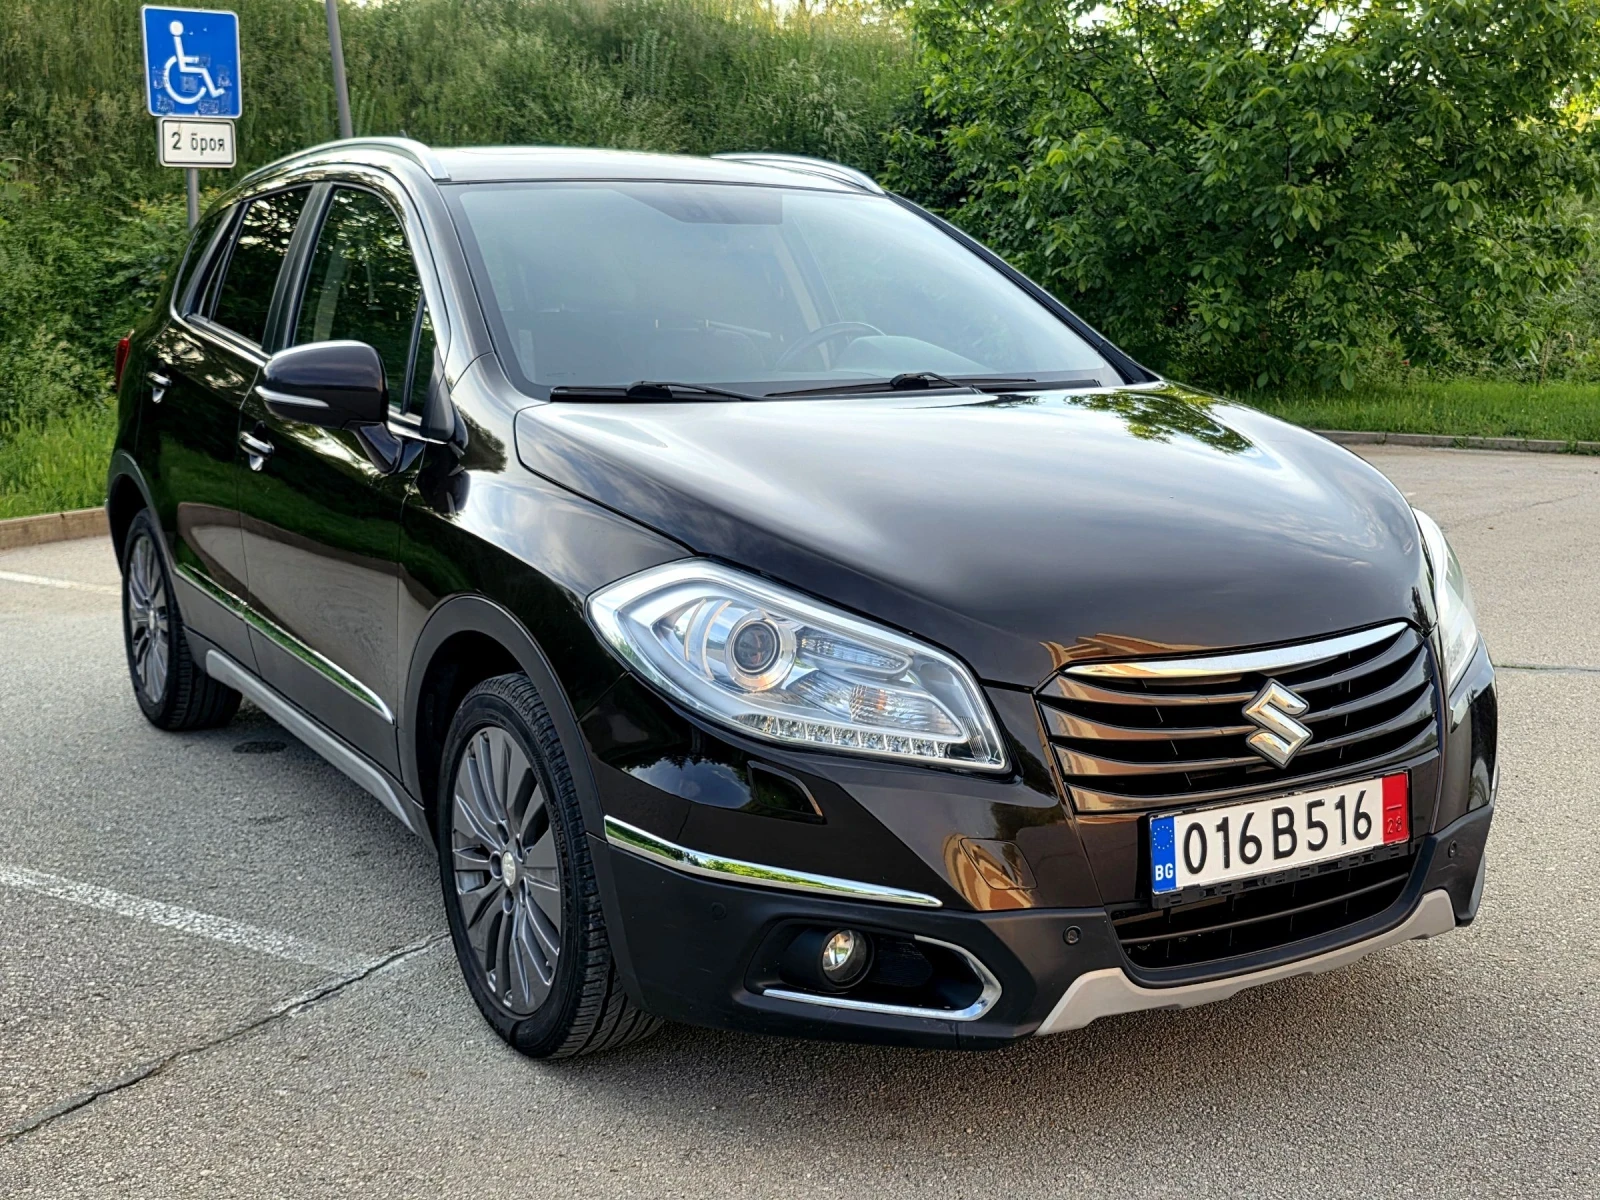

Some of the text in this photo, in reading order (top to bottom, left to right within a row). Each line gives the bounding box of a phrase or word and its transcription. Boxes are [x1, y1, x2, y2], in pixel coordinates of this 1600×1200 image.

[171, 131, 226, 156] 2 броя
[1183, 790, 1372, 875] 016B516
[1155, 863, 1174, 881] BG
